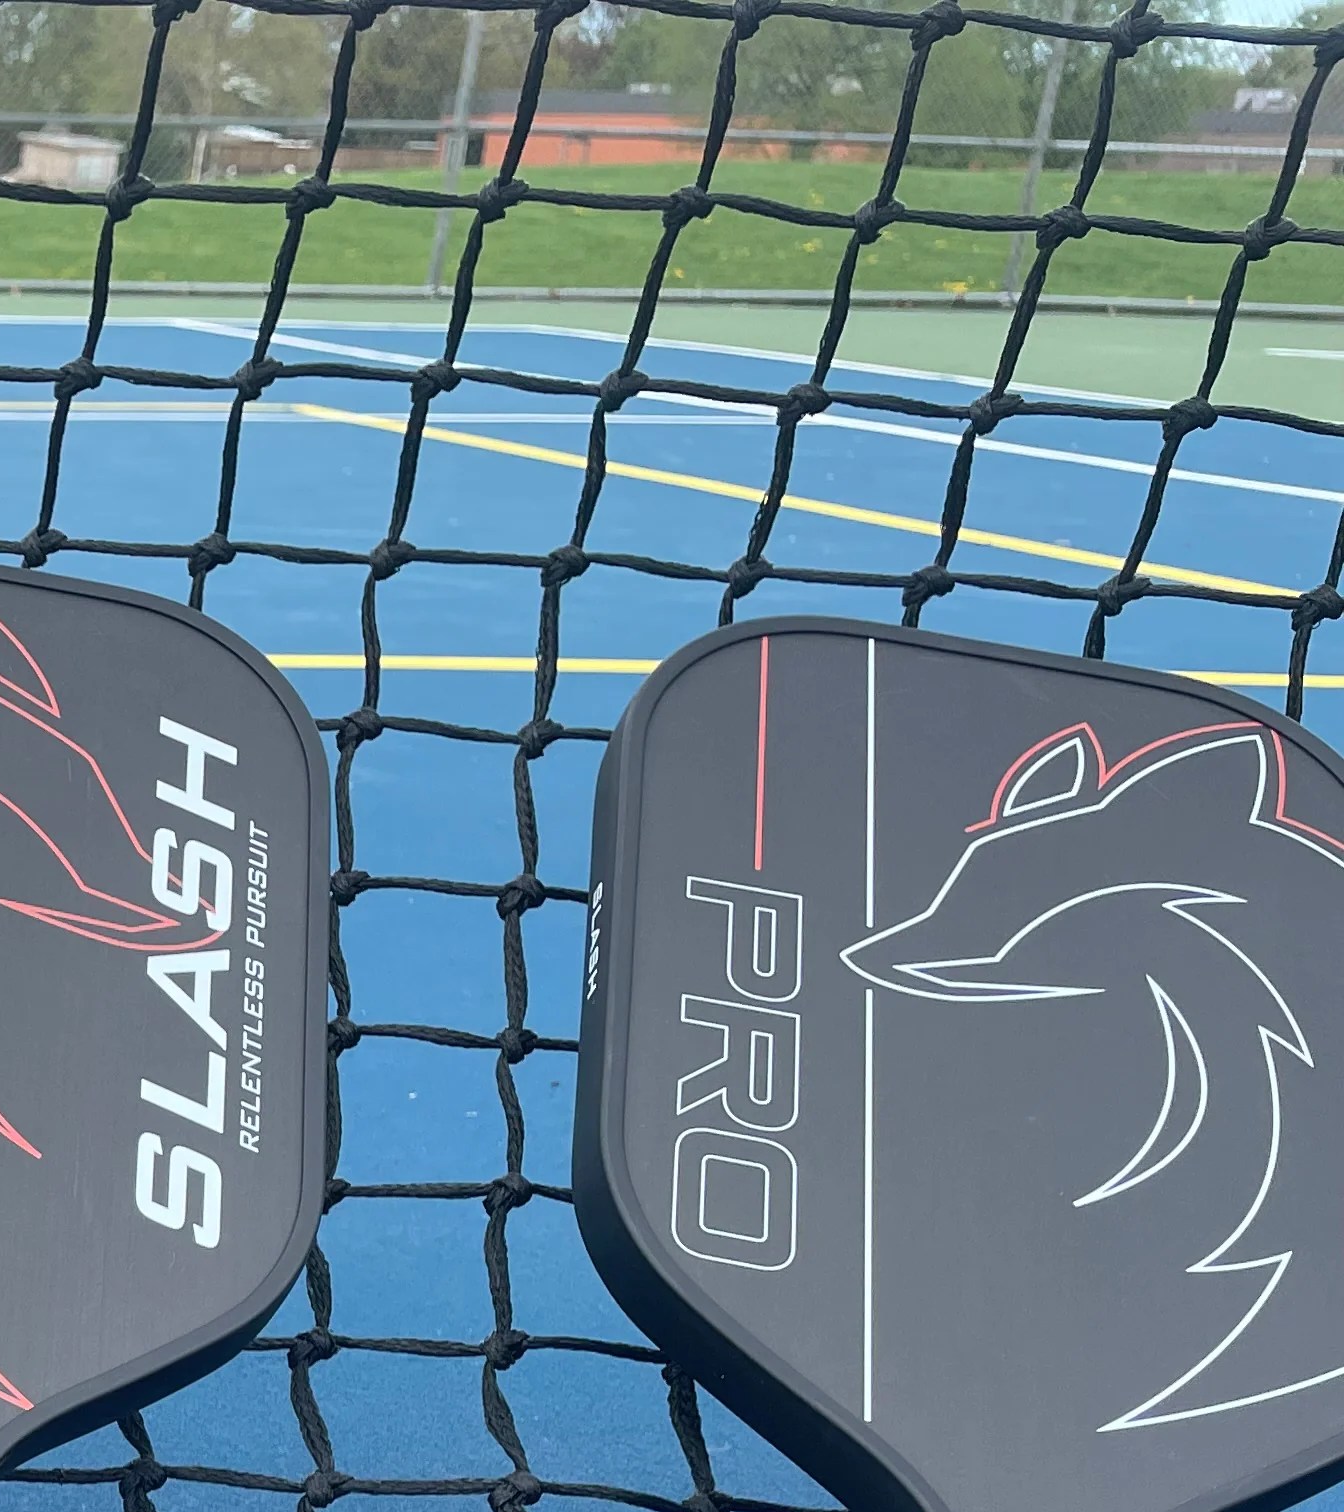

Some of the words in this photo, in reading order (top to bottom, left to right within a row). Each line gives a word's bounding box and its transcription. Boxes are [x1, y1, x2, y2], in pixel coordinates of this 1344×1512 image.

[246, 820, 270, 948] PURSUIT
[586, 881, 603, 1000] SLASH
[136, 716, 238, 1249] SLASH
[239, 957, 266, 1153] RELENTLESS
[671, 875, 803, 1271] PRO
